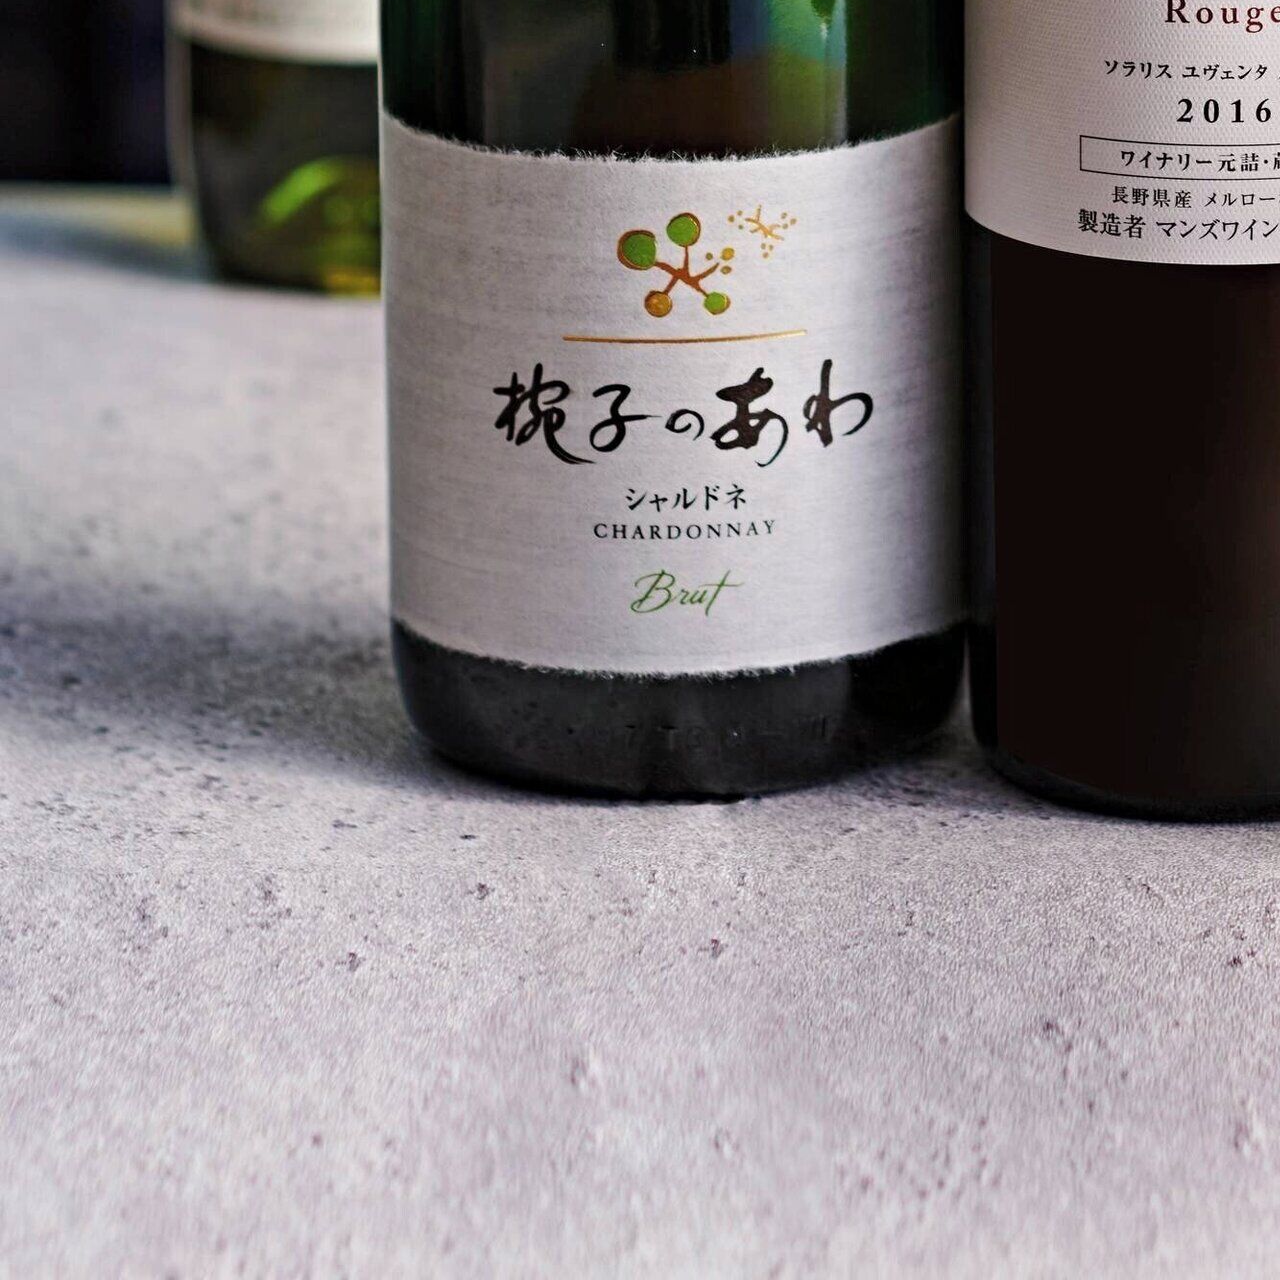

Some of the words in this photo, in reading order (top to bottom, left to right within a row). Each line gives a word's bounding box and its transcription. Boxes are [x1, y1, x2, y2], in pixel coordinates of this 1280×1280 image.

[1104, 58, 1172, 80] ソラリス
[1182, 63, 1268, 82] ユヴェンタ
[1176, 97, 1272, 124] 2016
[1111, 184, 1192, 209] 長野県産
[1077, 208, 1147, 239] 製造者
[624, 483, 747, 512] シャルドネ
[593, 519, 776, 540] CHARDONNAY
[629, 569, 747, 618] Brut
